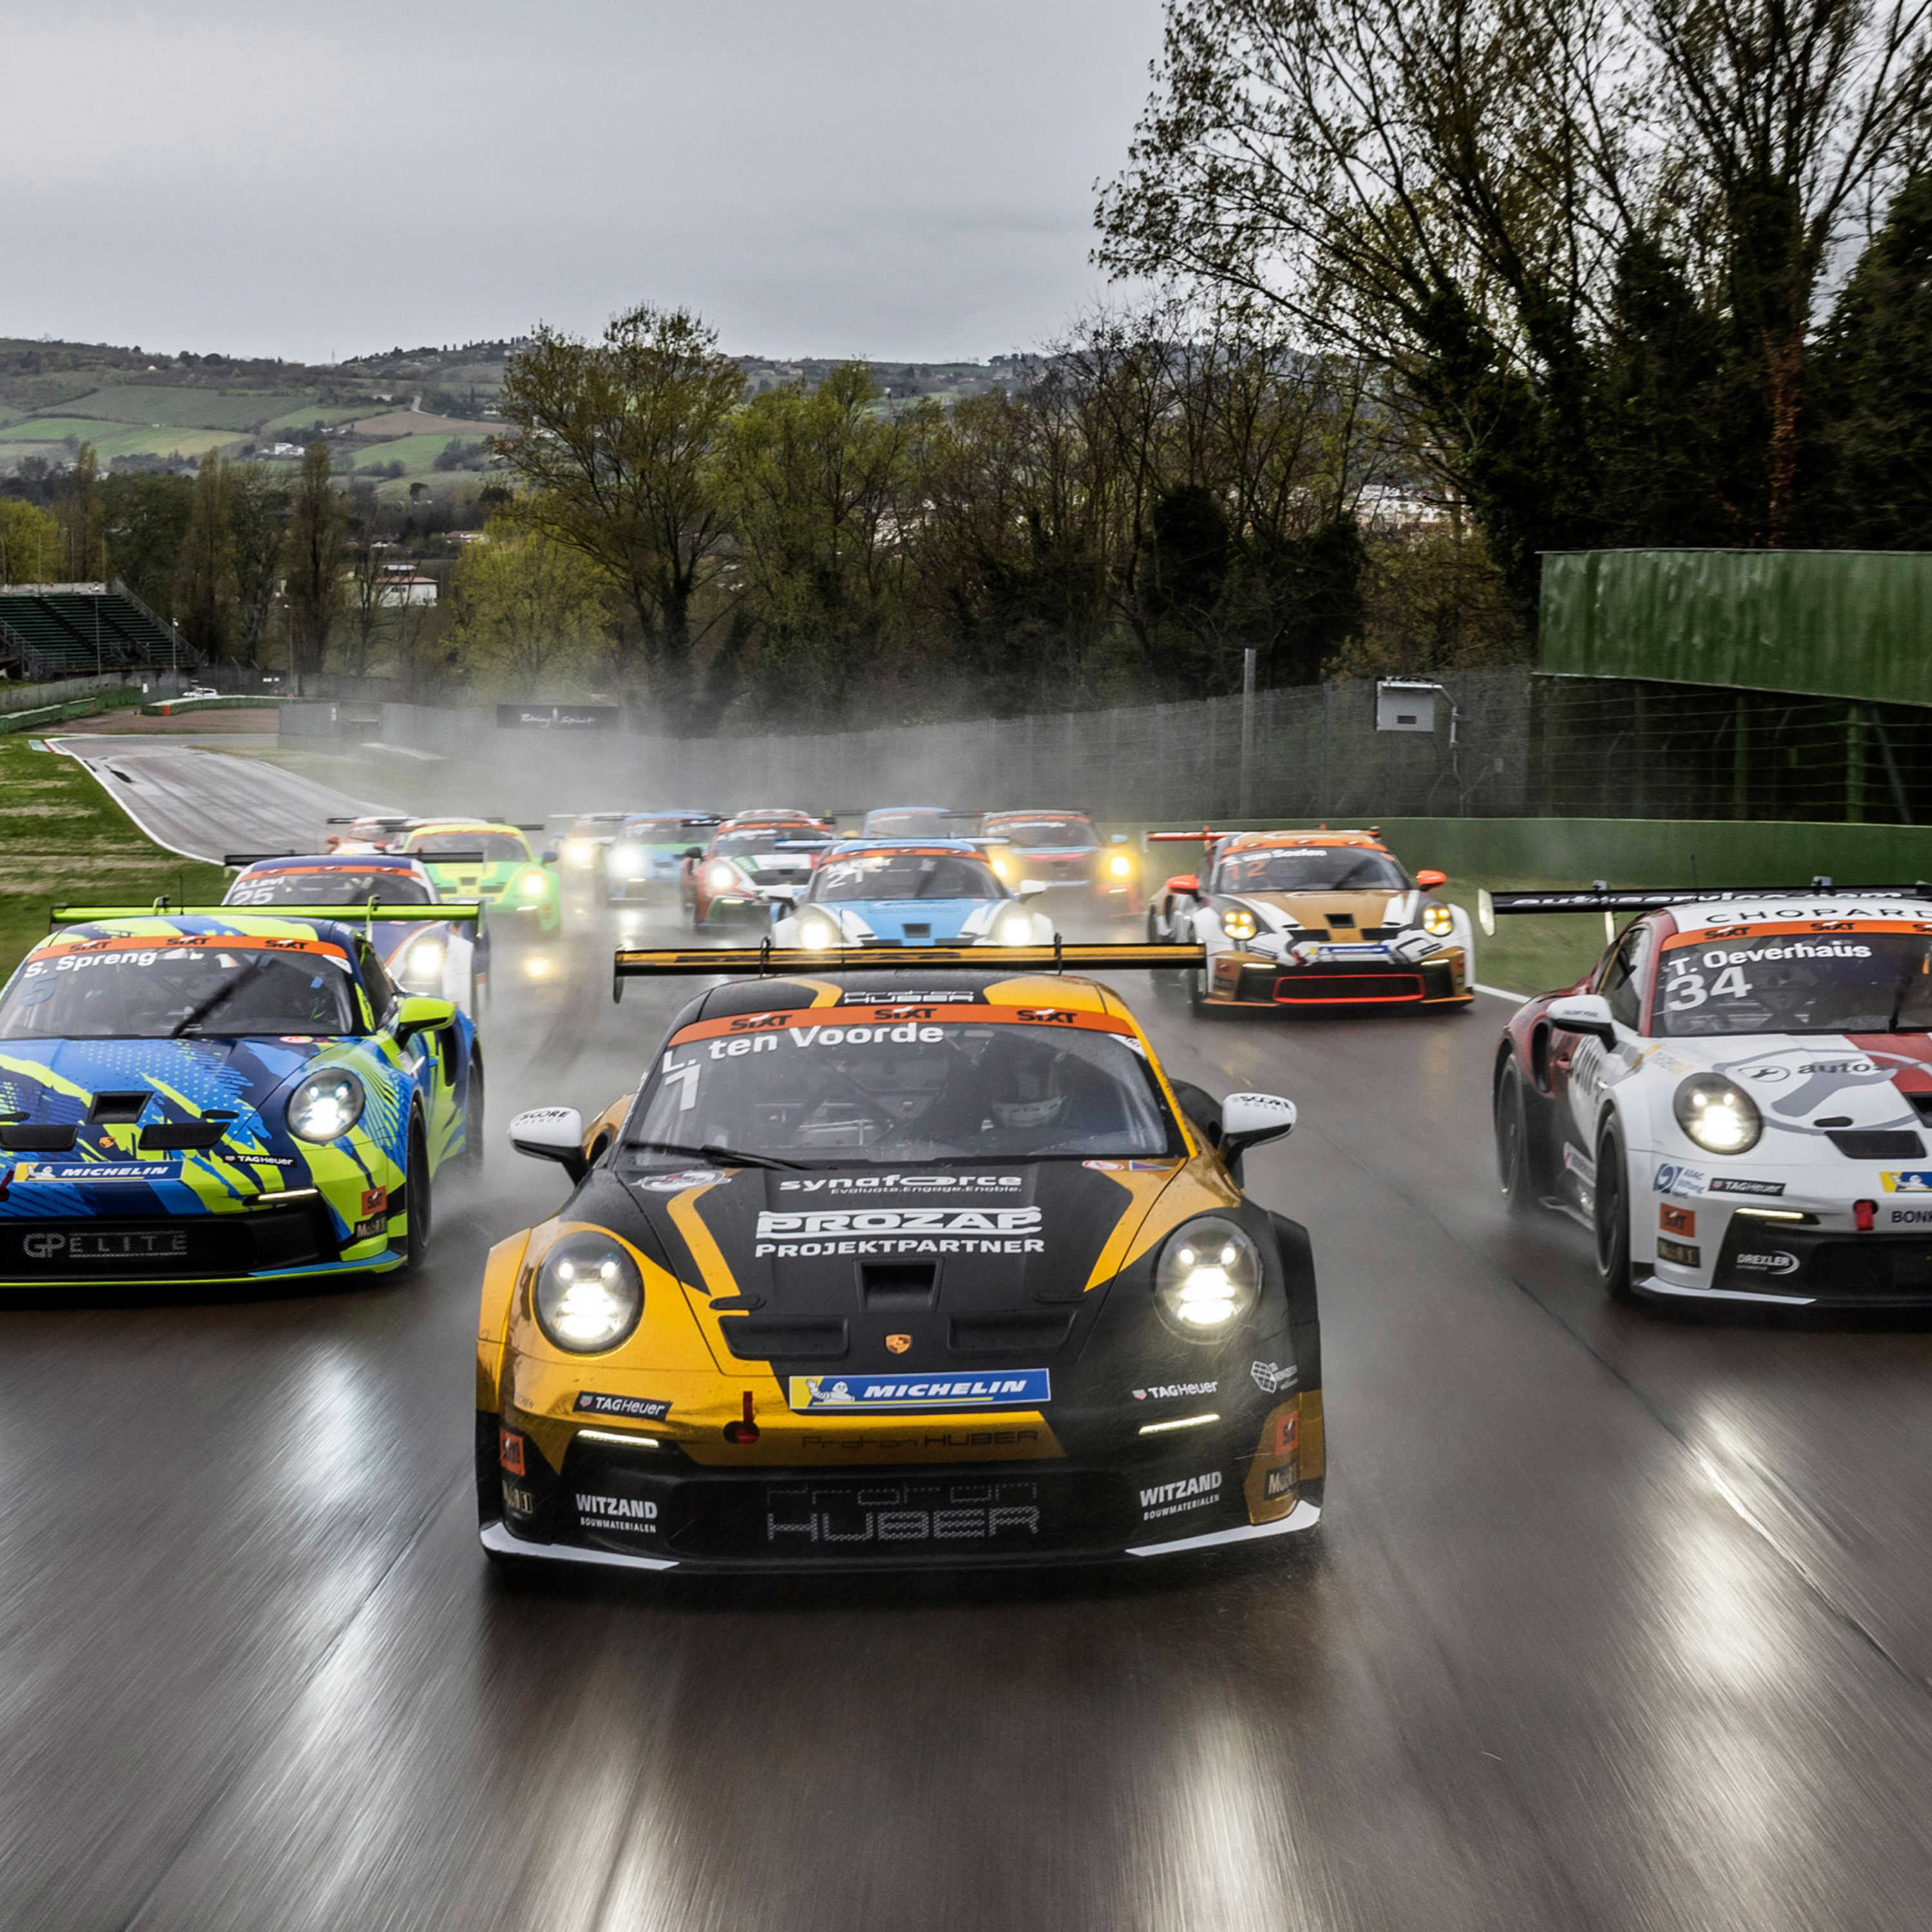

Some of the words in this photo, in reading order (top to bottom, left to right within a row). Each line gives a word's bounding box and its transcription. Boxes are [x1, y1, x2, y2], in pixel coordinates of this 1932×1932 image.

[1225, 860, 1267, 880] 12
[234, 887, 276, 905] 25
[24, 961, 48, 978] S.
[55, 952, 157, 972] Spreng
[1668, 957, 1698, 976] T.
[21, 971, 59, 1007] 5
[1665, 966, 1754, 1011] 34
[661, 1050, 697, 1074] L.
[709, 1034, 778, 1059] ten
[789, 1022, 944, 1047] Voorde
[664, 1063, 701, 1112] 1
[61, 1166, 169, 1177] MICHELIN
[756, 1211, 1042, 1234] PROZAP
[1891, 1210, 1932, 1223] BON
[755, 1238, 1045, 1257] PROJEKTPARTNER
[863, 1379, 1027, 1398] MICHELIN
[925, 1430, 1038, 1447] HUBER
[1140, 1471, 1222, 1508] WITZAND
[576, 1493, 658, 1519] WITZAND
[1143, 1494, 1220, 1521] BOUWMATERIALEN
[580, 1517, 657, 1533] BOUWMATERIALEN
[767, 1506, 1039, 1542] HUBER
